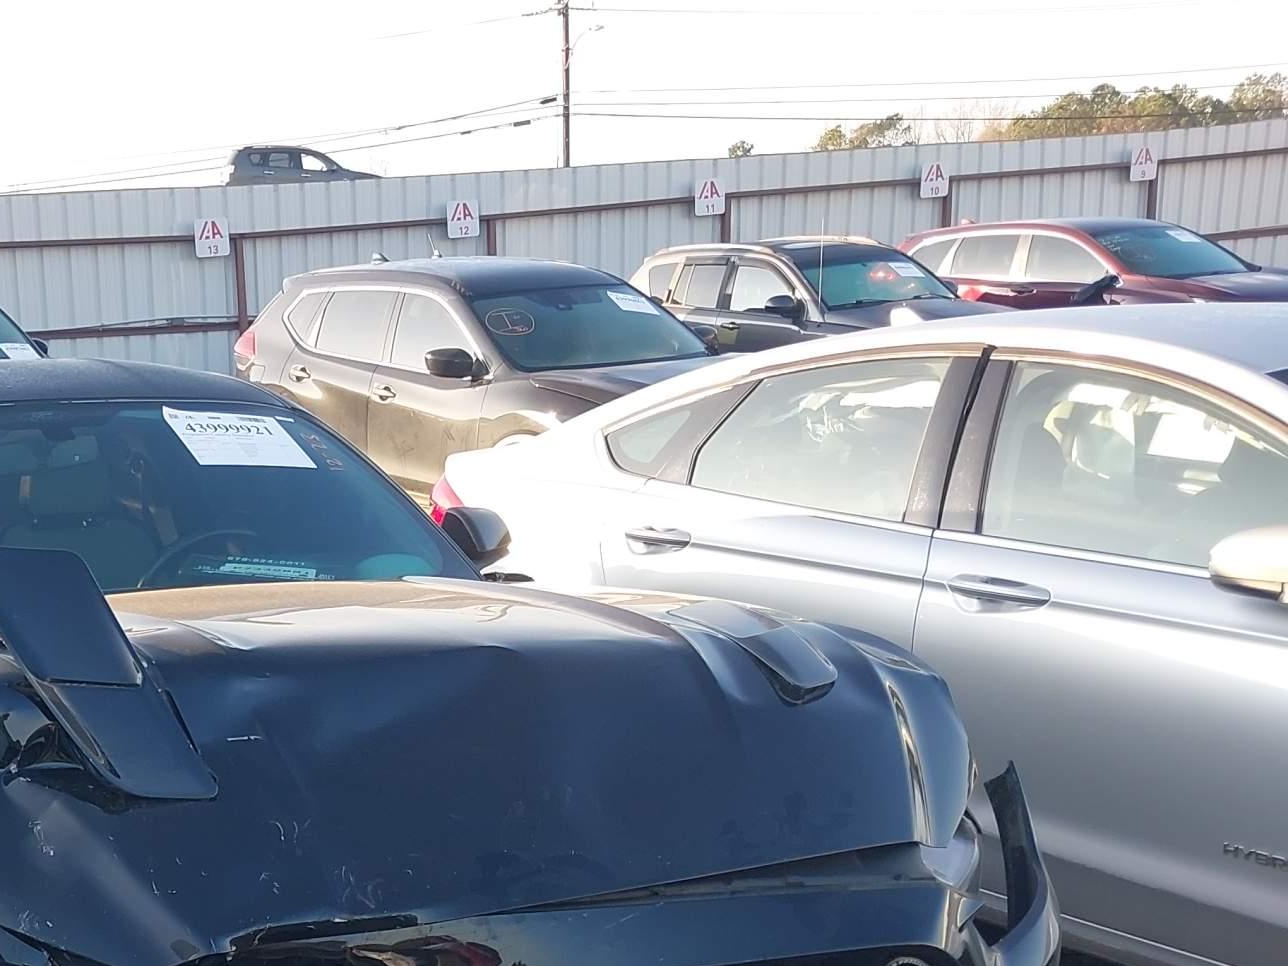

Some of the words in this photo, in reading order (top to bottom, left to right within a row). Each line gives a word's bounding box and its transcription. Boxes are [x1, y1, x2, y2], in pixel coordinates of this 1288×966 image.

[930, 186, 941, 196] 10
[705, 203, 716, 213] 11
[458, 225, 471, 236] 12
[207, 244, 220, 256] 13
[185, 421, 274, 437] 43999921
